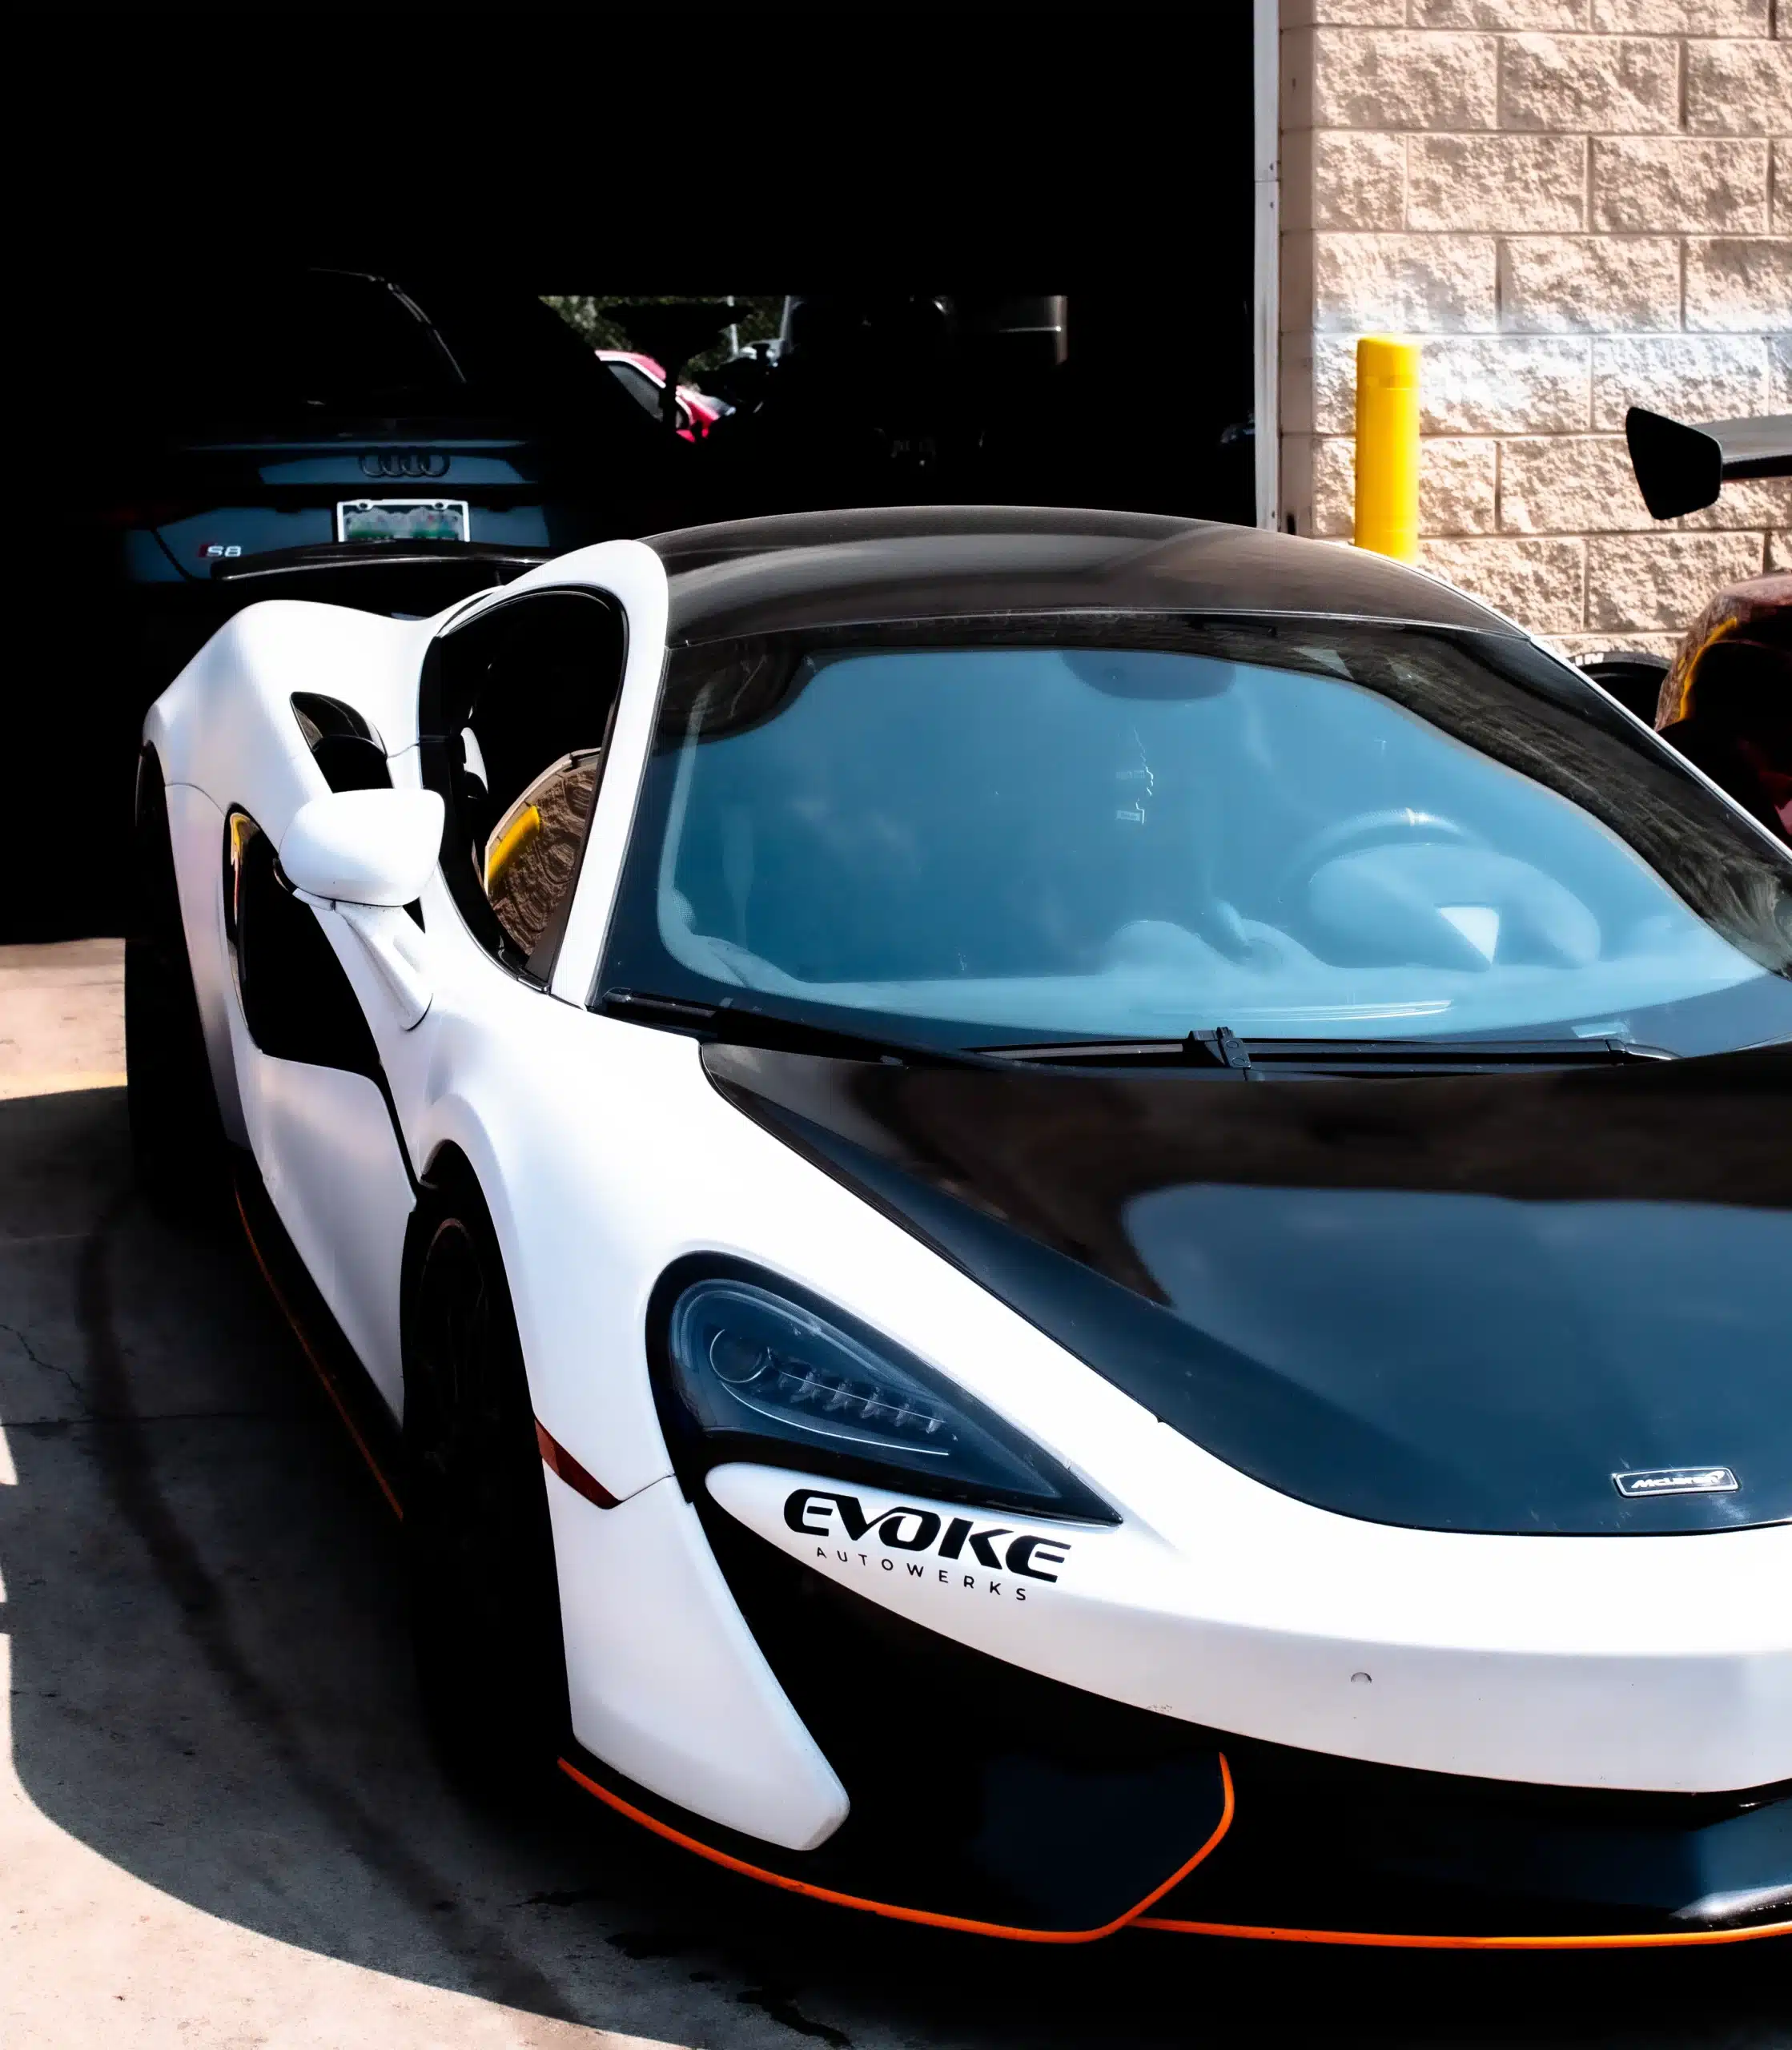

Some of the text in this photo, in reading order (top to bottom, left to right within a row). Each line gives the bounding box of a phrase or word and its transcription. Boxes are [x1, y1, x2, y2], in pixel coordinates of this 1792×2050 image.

[207, 545, 241, 557] S8
[1572, 653, 1604, 666] IN
[784, 1489, 1071, 1583] EVOKE
[817, 1546, 1027, 1601] AUTOWERKS
